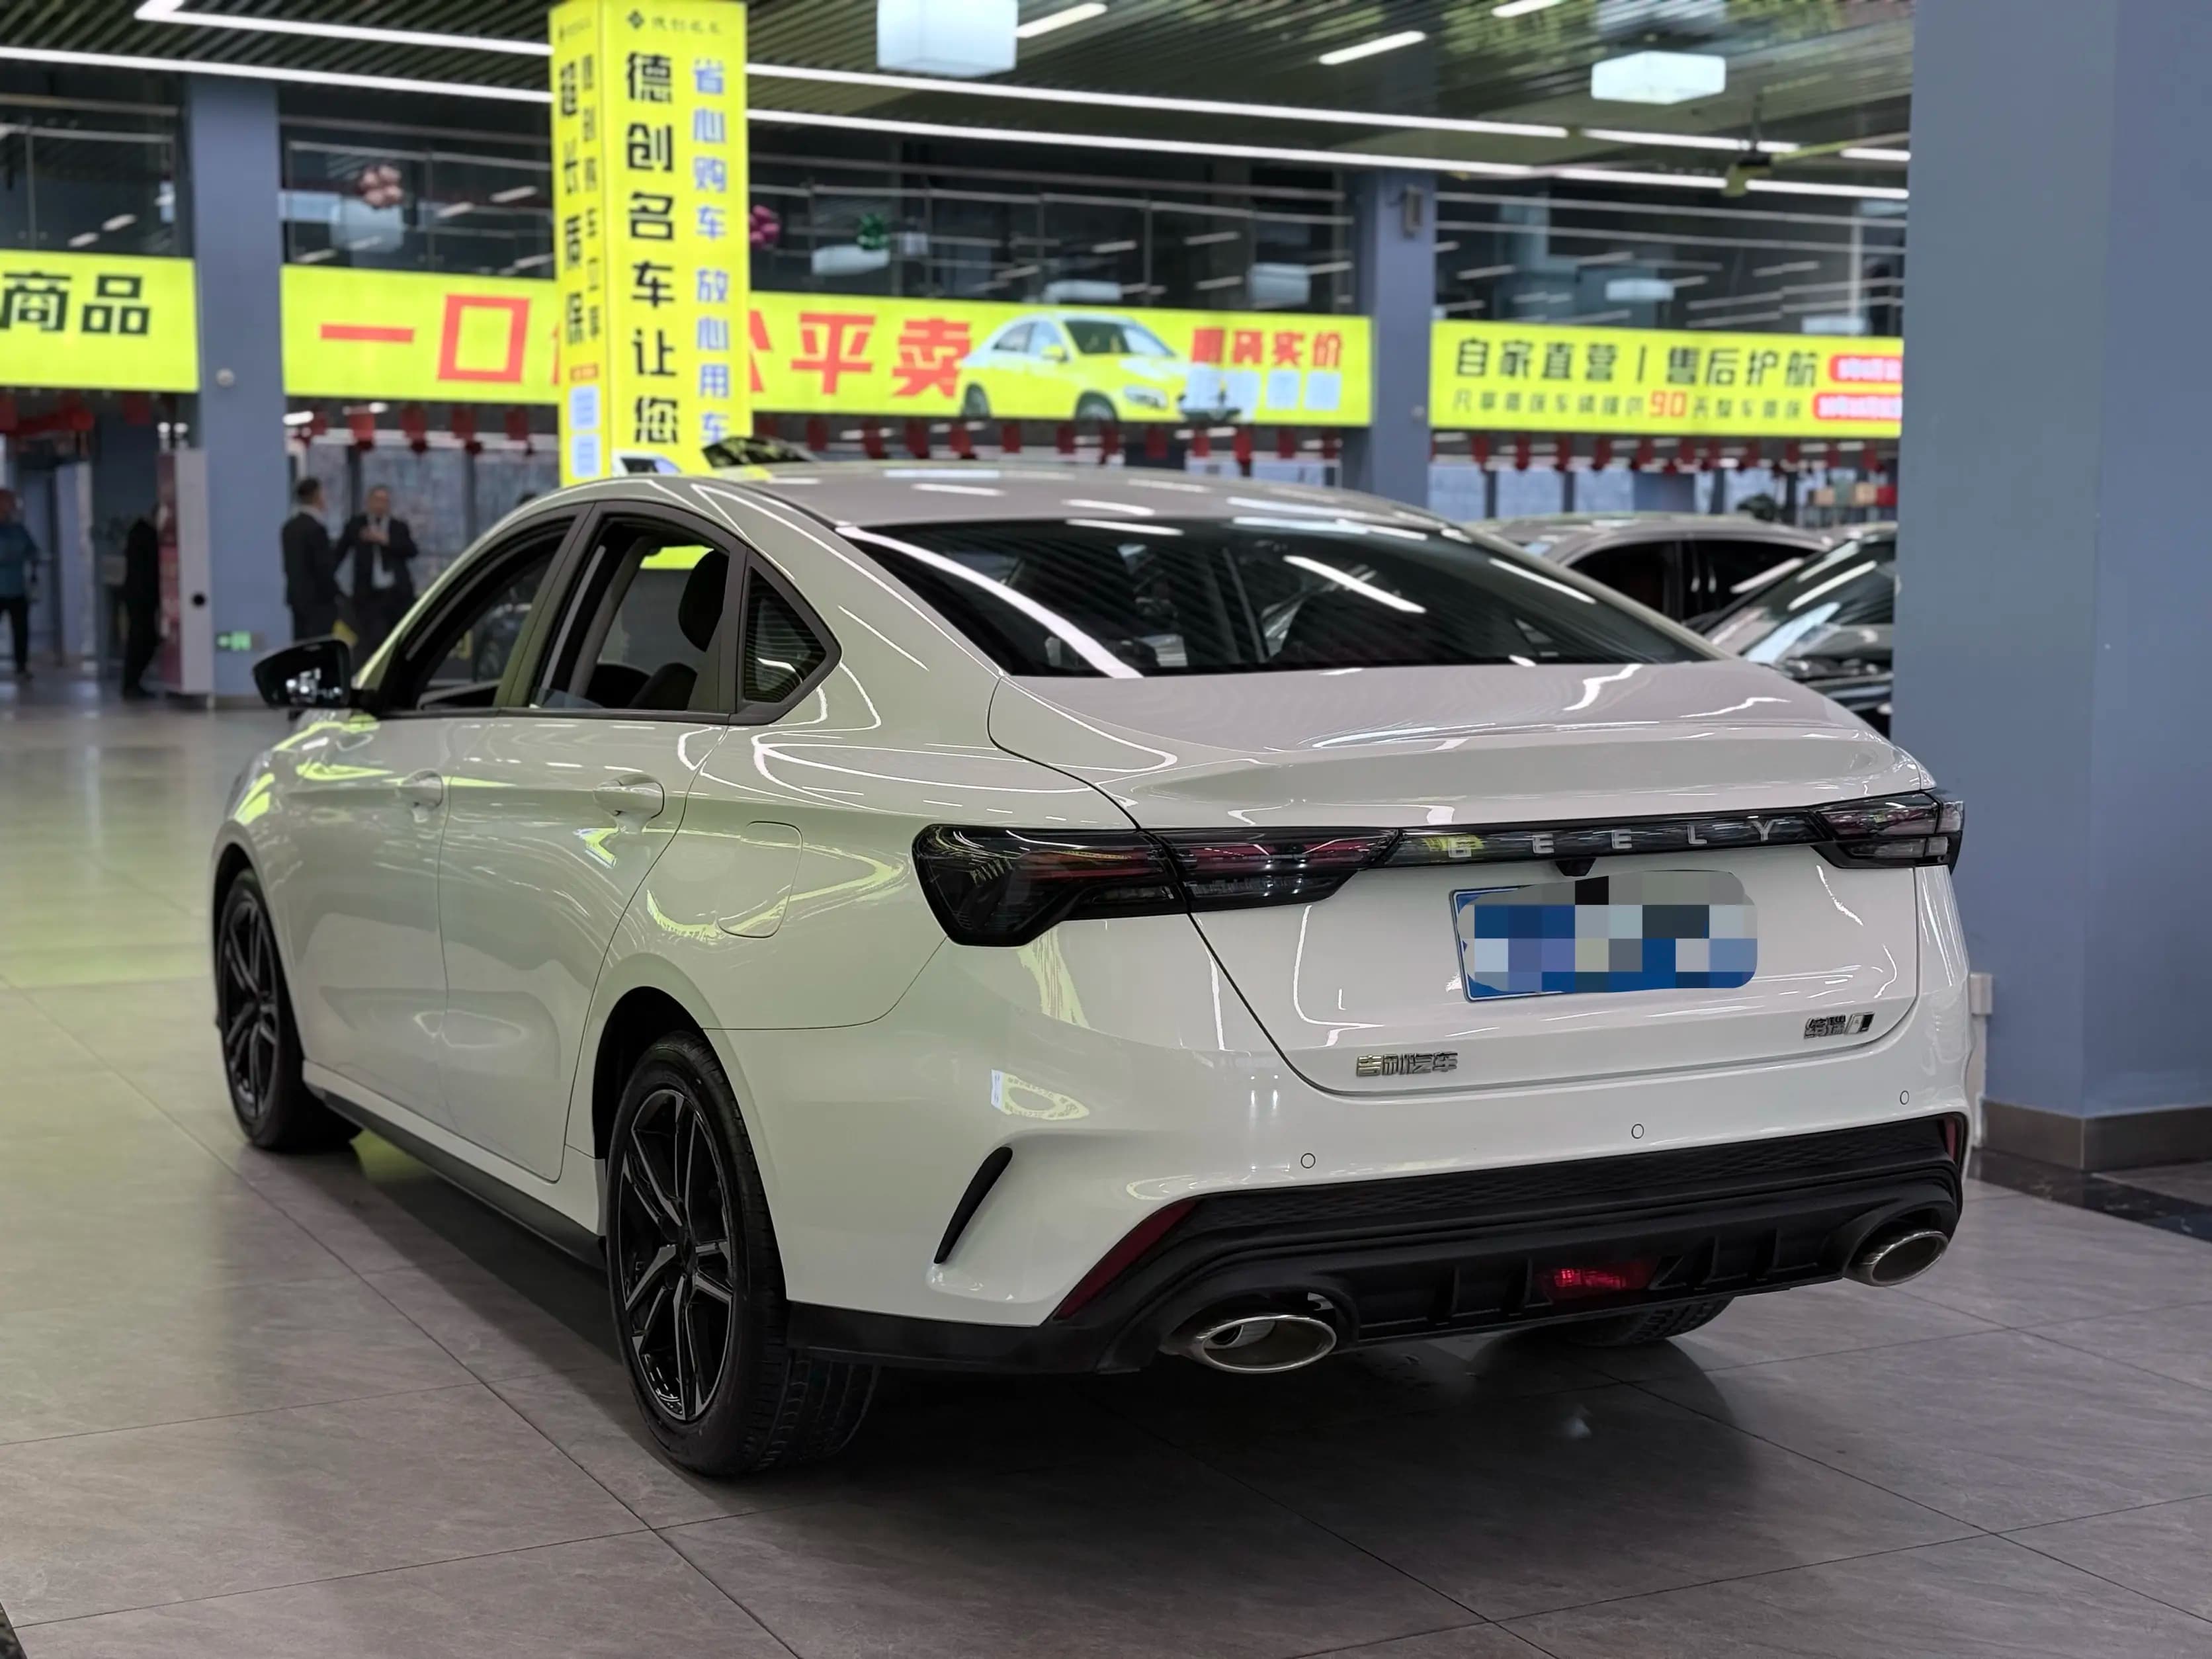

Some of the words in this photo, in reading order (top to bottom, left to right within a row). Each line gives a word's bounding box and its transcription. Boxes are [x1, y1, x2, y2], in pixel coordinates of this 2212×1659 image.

[626, 52, 678, 444] 德创名车让您
[0, 271, 150, 335] 商品
[320, 294, 559, 386] 一口
[1447, 818, 1779, 859] GEELY
[1356, 1051, 1459, 1078] 吉利汽车
